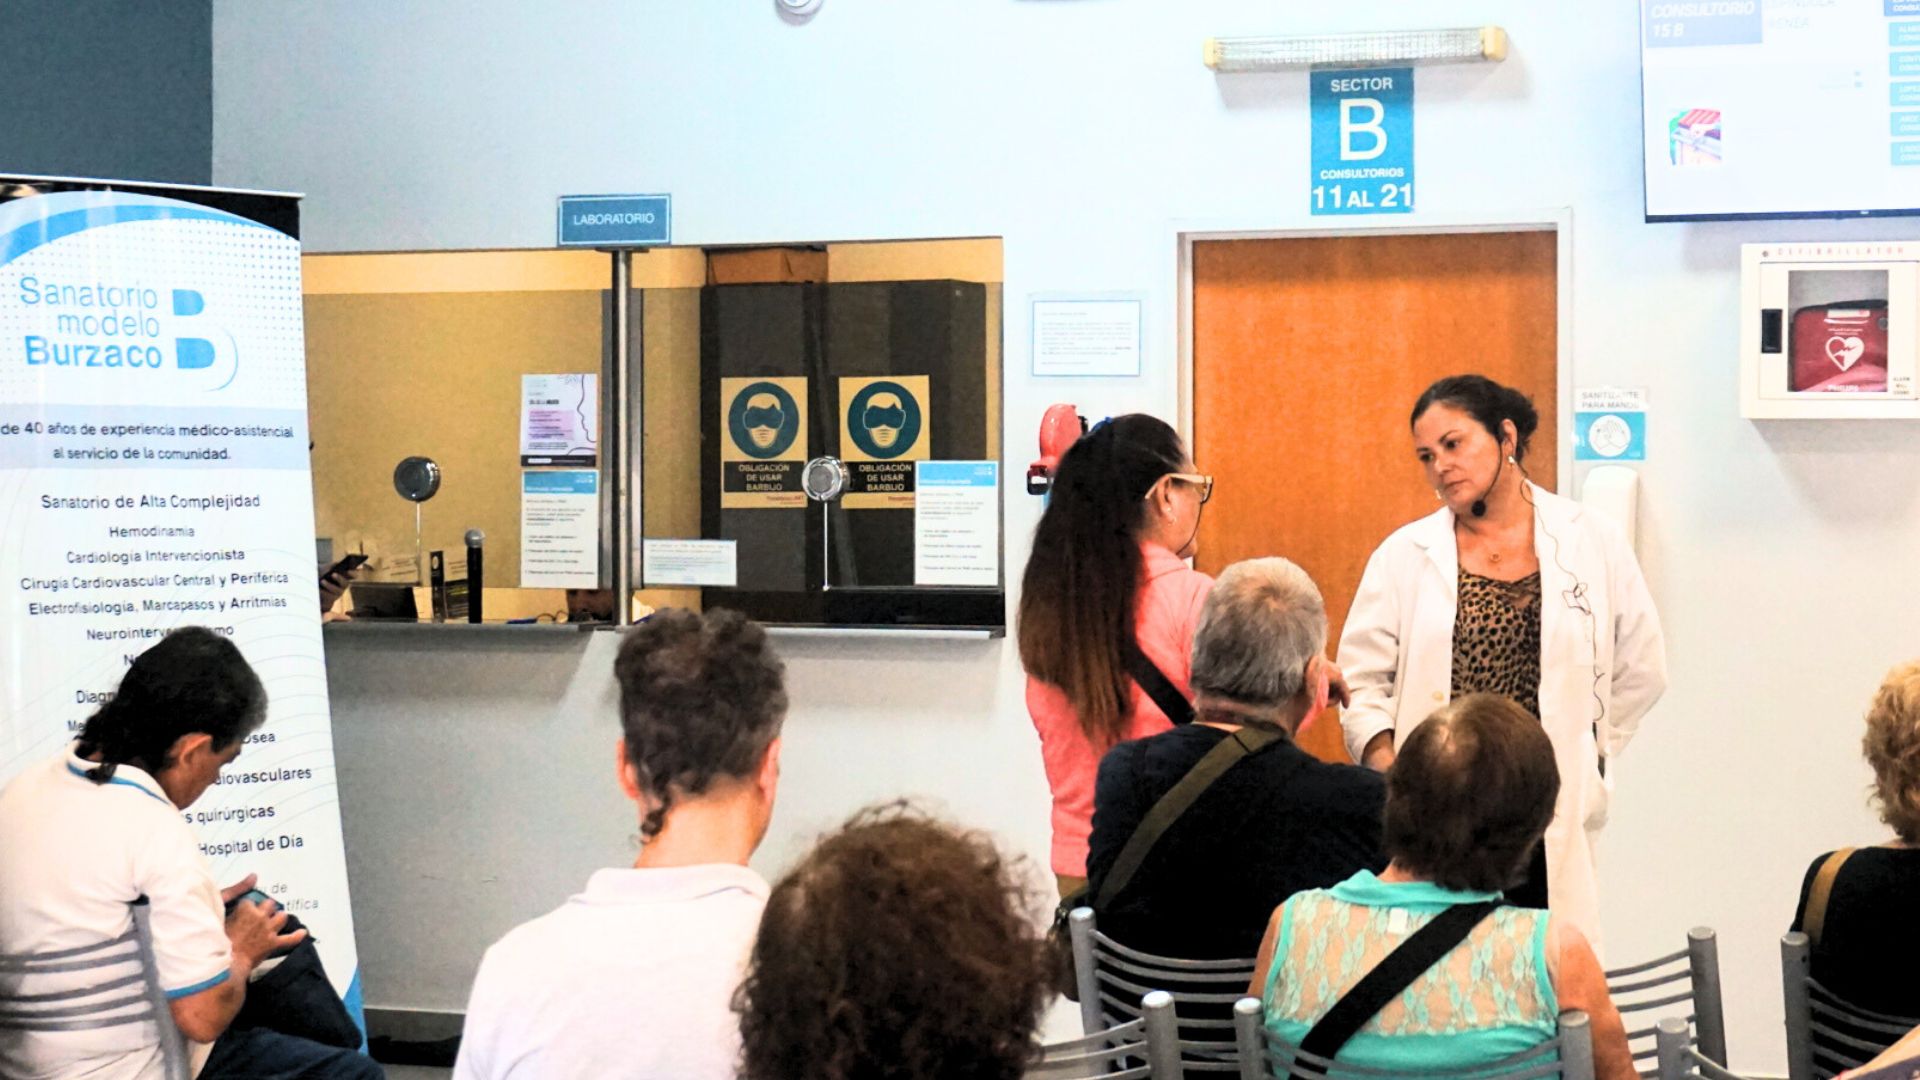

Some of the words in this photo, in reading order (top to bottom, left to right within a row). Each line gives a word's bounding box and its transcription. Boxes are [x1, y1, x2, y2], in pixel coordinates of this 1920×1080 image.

[1651, 1, 1755, 18] CONSULTORIO
[1653, 23, 1671, 38] 15
[1331, 77, 1393, 92] SECTOR
[1340, 97, 1388, 161] B
[1320, 167, 1405, 180] CONSULTORIOS
[1312, 184, 1342, 209] 11
[1346, 190, 1375, 208] AL
[1380, 183, 1412, 208] 21
[573, 212, 655, 226] LABORATORIO
[19, 276, 158, 309] Sanatorio
[57, 309, 160, 338] modelo
[24, 335, 163, 369] Burzaco
[0, 423, 20, 435] de
[24, 422, 44, 434] 40
[47, 422, 77, 435] años
[80, 423, 97, 435] de
[100, 423, 176, 437] experiencia
[178, 424, 294, 438] médico-asistencial
[53, 446, 64, 459] al
[67, 447, 119, 460] servicio
[122, 447, 140, 459] de
[144, 447, 155, 459] la
[158, 447, 232, 460] comunidad.
[746, 473, 758, 481] DE
[759, 473, 782, 481] USAR
[867, 474, 879, 482] DE
[880, 474, 905, 482] USAR
[746, 483, 783, 491] BARBIJO
[867, 483, 905, 492] BARBIJO
[41, 495, 110, 509] Sanatorio
[115, 495, 135, 508] de
[140, 495, 166, 508] Alta
[170, 494, 261, 511] Complejidad
[109, 525, 195, 538] Hemodinamia
[145, 550, 246, 562] Intervencionista
[72, 575, 169, 589] Cardiovascular
[173, 574, 215, 587] Central
[219, 576, 227, 588] y
[142, 599, 215, 613] Marcapasos
[218, 600, 226, 612] y
[230, 597, 288, 609] Arritmias
[197, 804, 276, 825] quirúrgicas
[199, 839, 253, 857] Hospital
[256, 837, 275, 852] de
[279, 834, 304, 849] Día
